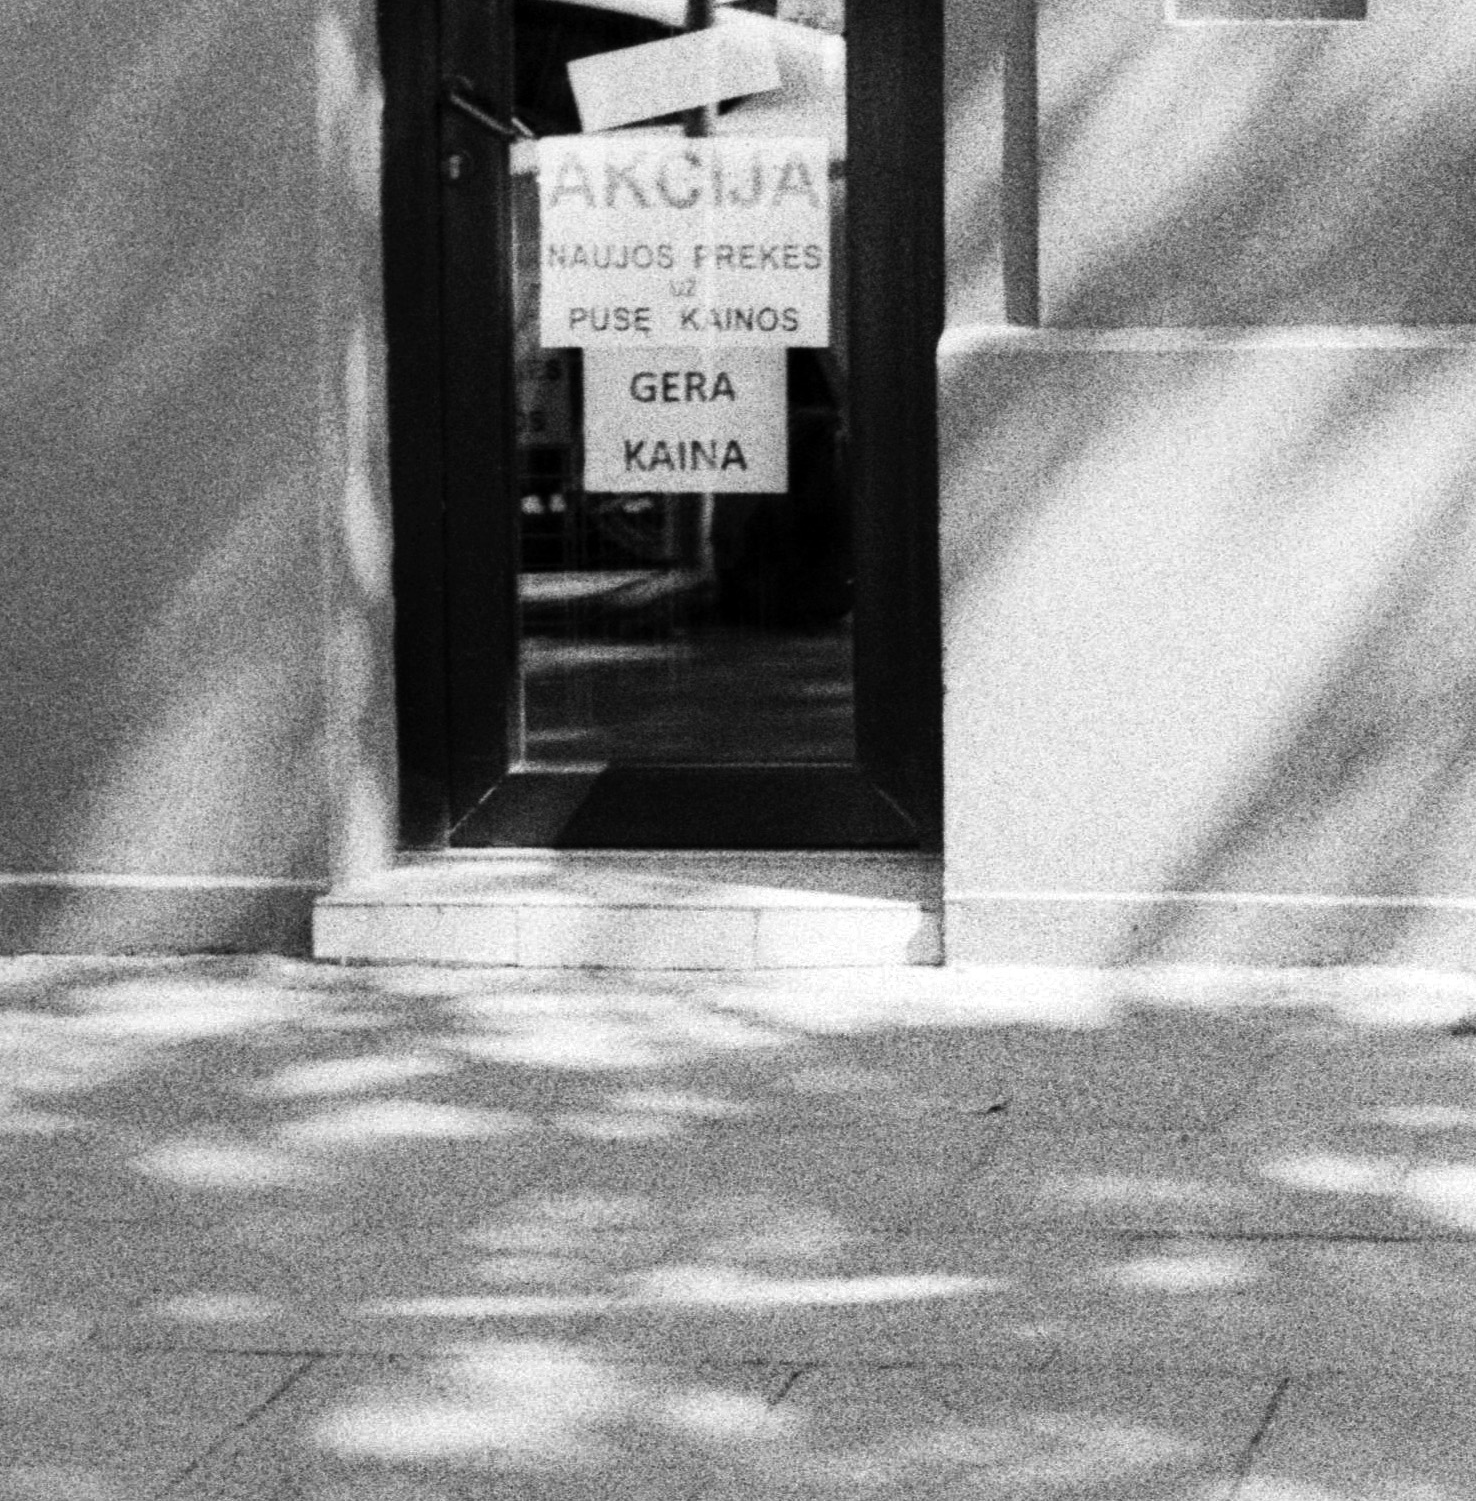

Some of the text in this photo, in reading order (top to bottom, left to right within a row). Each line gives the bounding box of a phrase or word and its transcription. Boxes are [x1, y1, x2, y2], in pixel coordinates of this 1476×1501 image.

[548, 150, 820, 209] AKCIJA
[547, 243, 675, 270] NAUJOS
[680, 306, 801, 333] KAINOS
[630, 371, 736, 403] GERA
[624, 439, 749, 472] KAINA
